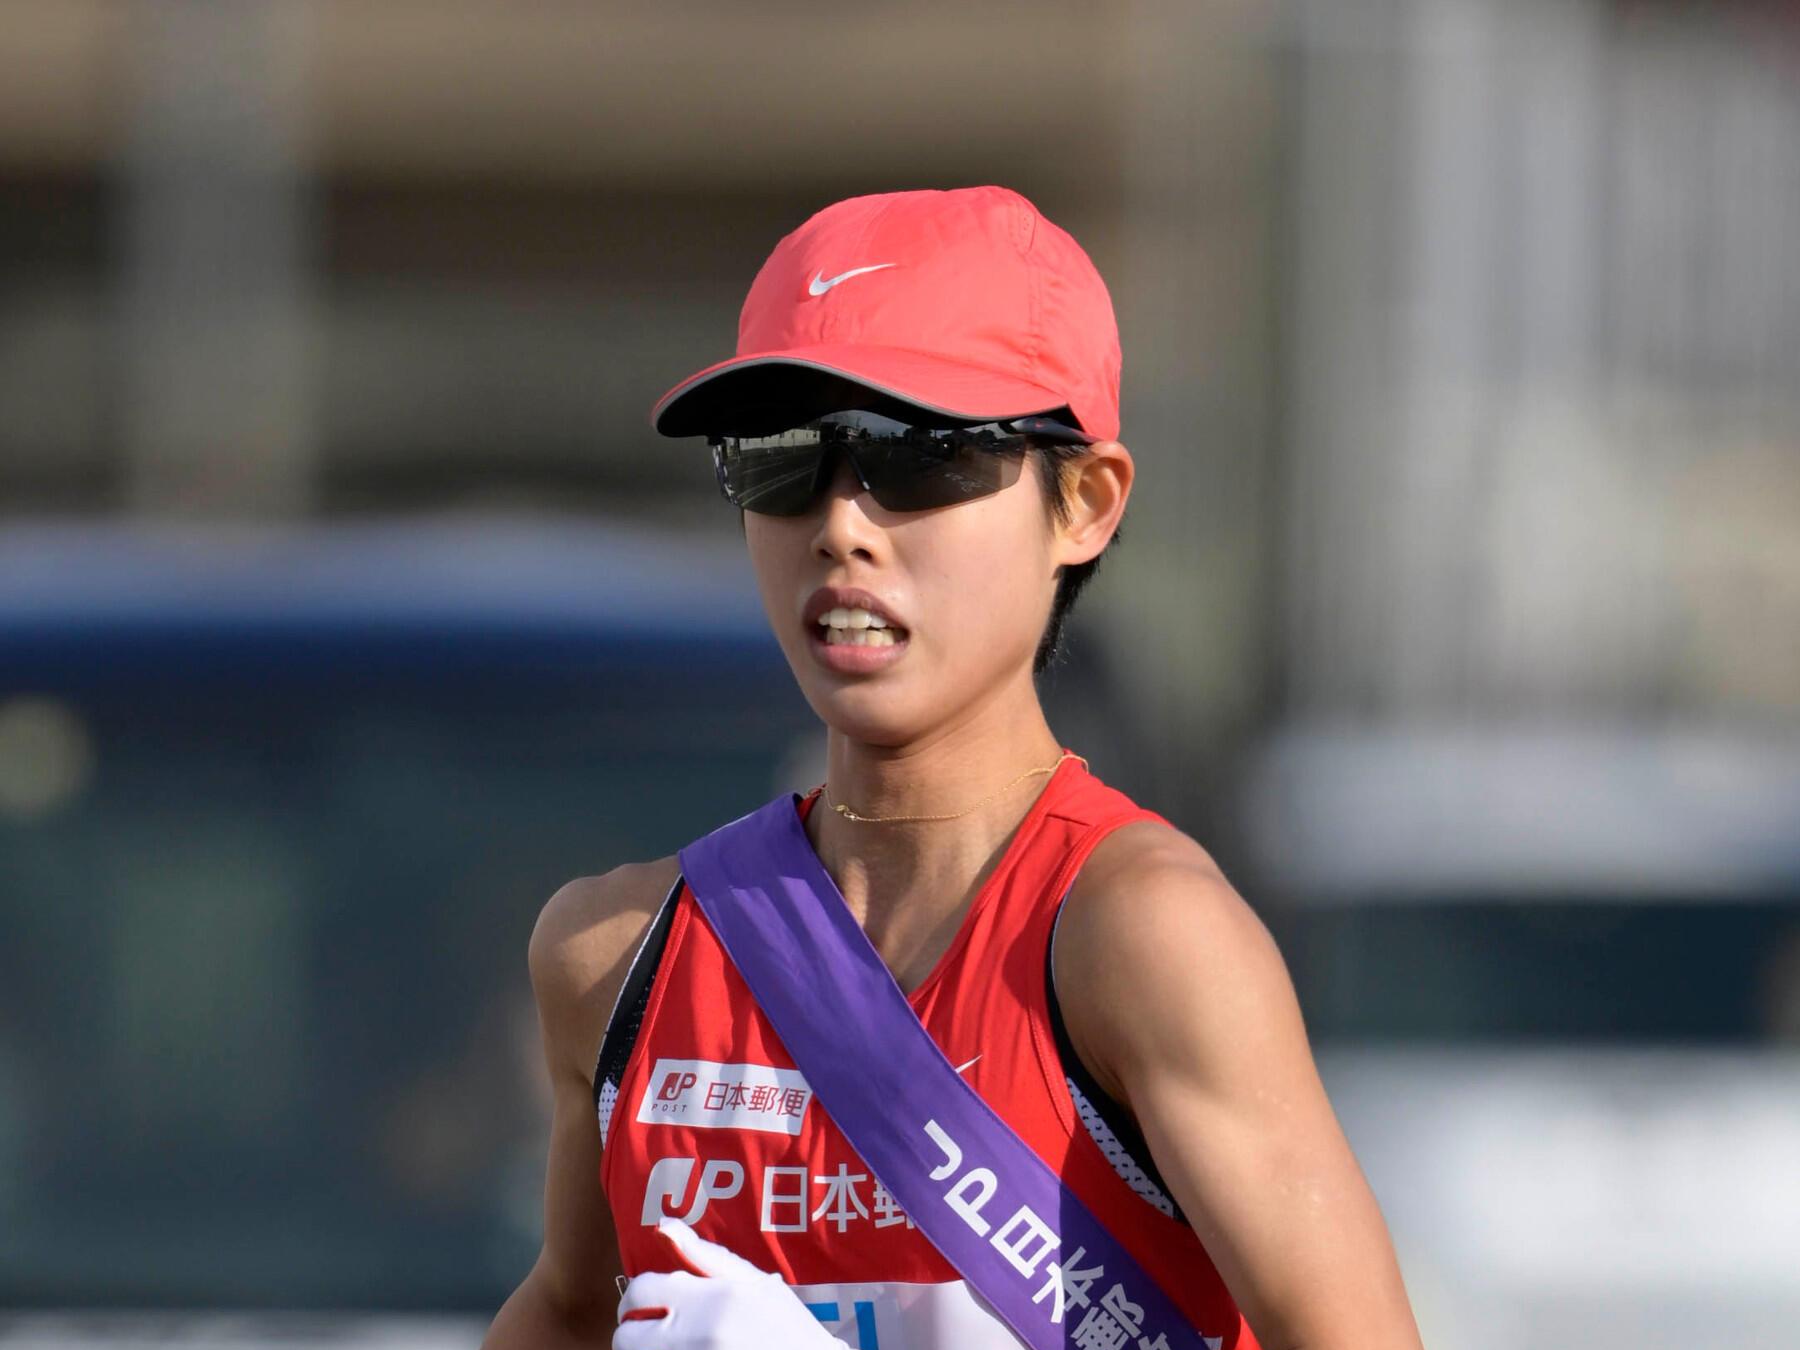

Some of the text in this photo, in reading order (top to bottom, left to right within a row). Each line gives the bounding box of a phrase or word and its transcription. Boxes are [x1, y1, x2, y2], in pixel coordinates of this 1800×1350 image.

[651, 1103, 688, 1113] POST
[703, 1082, 806, 1118] 日本郵便
[641, 1157, 745, 1227] JP
